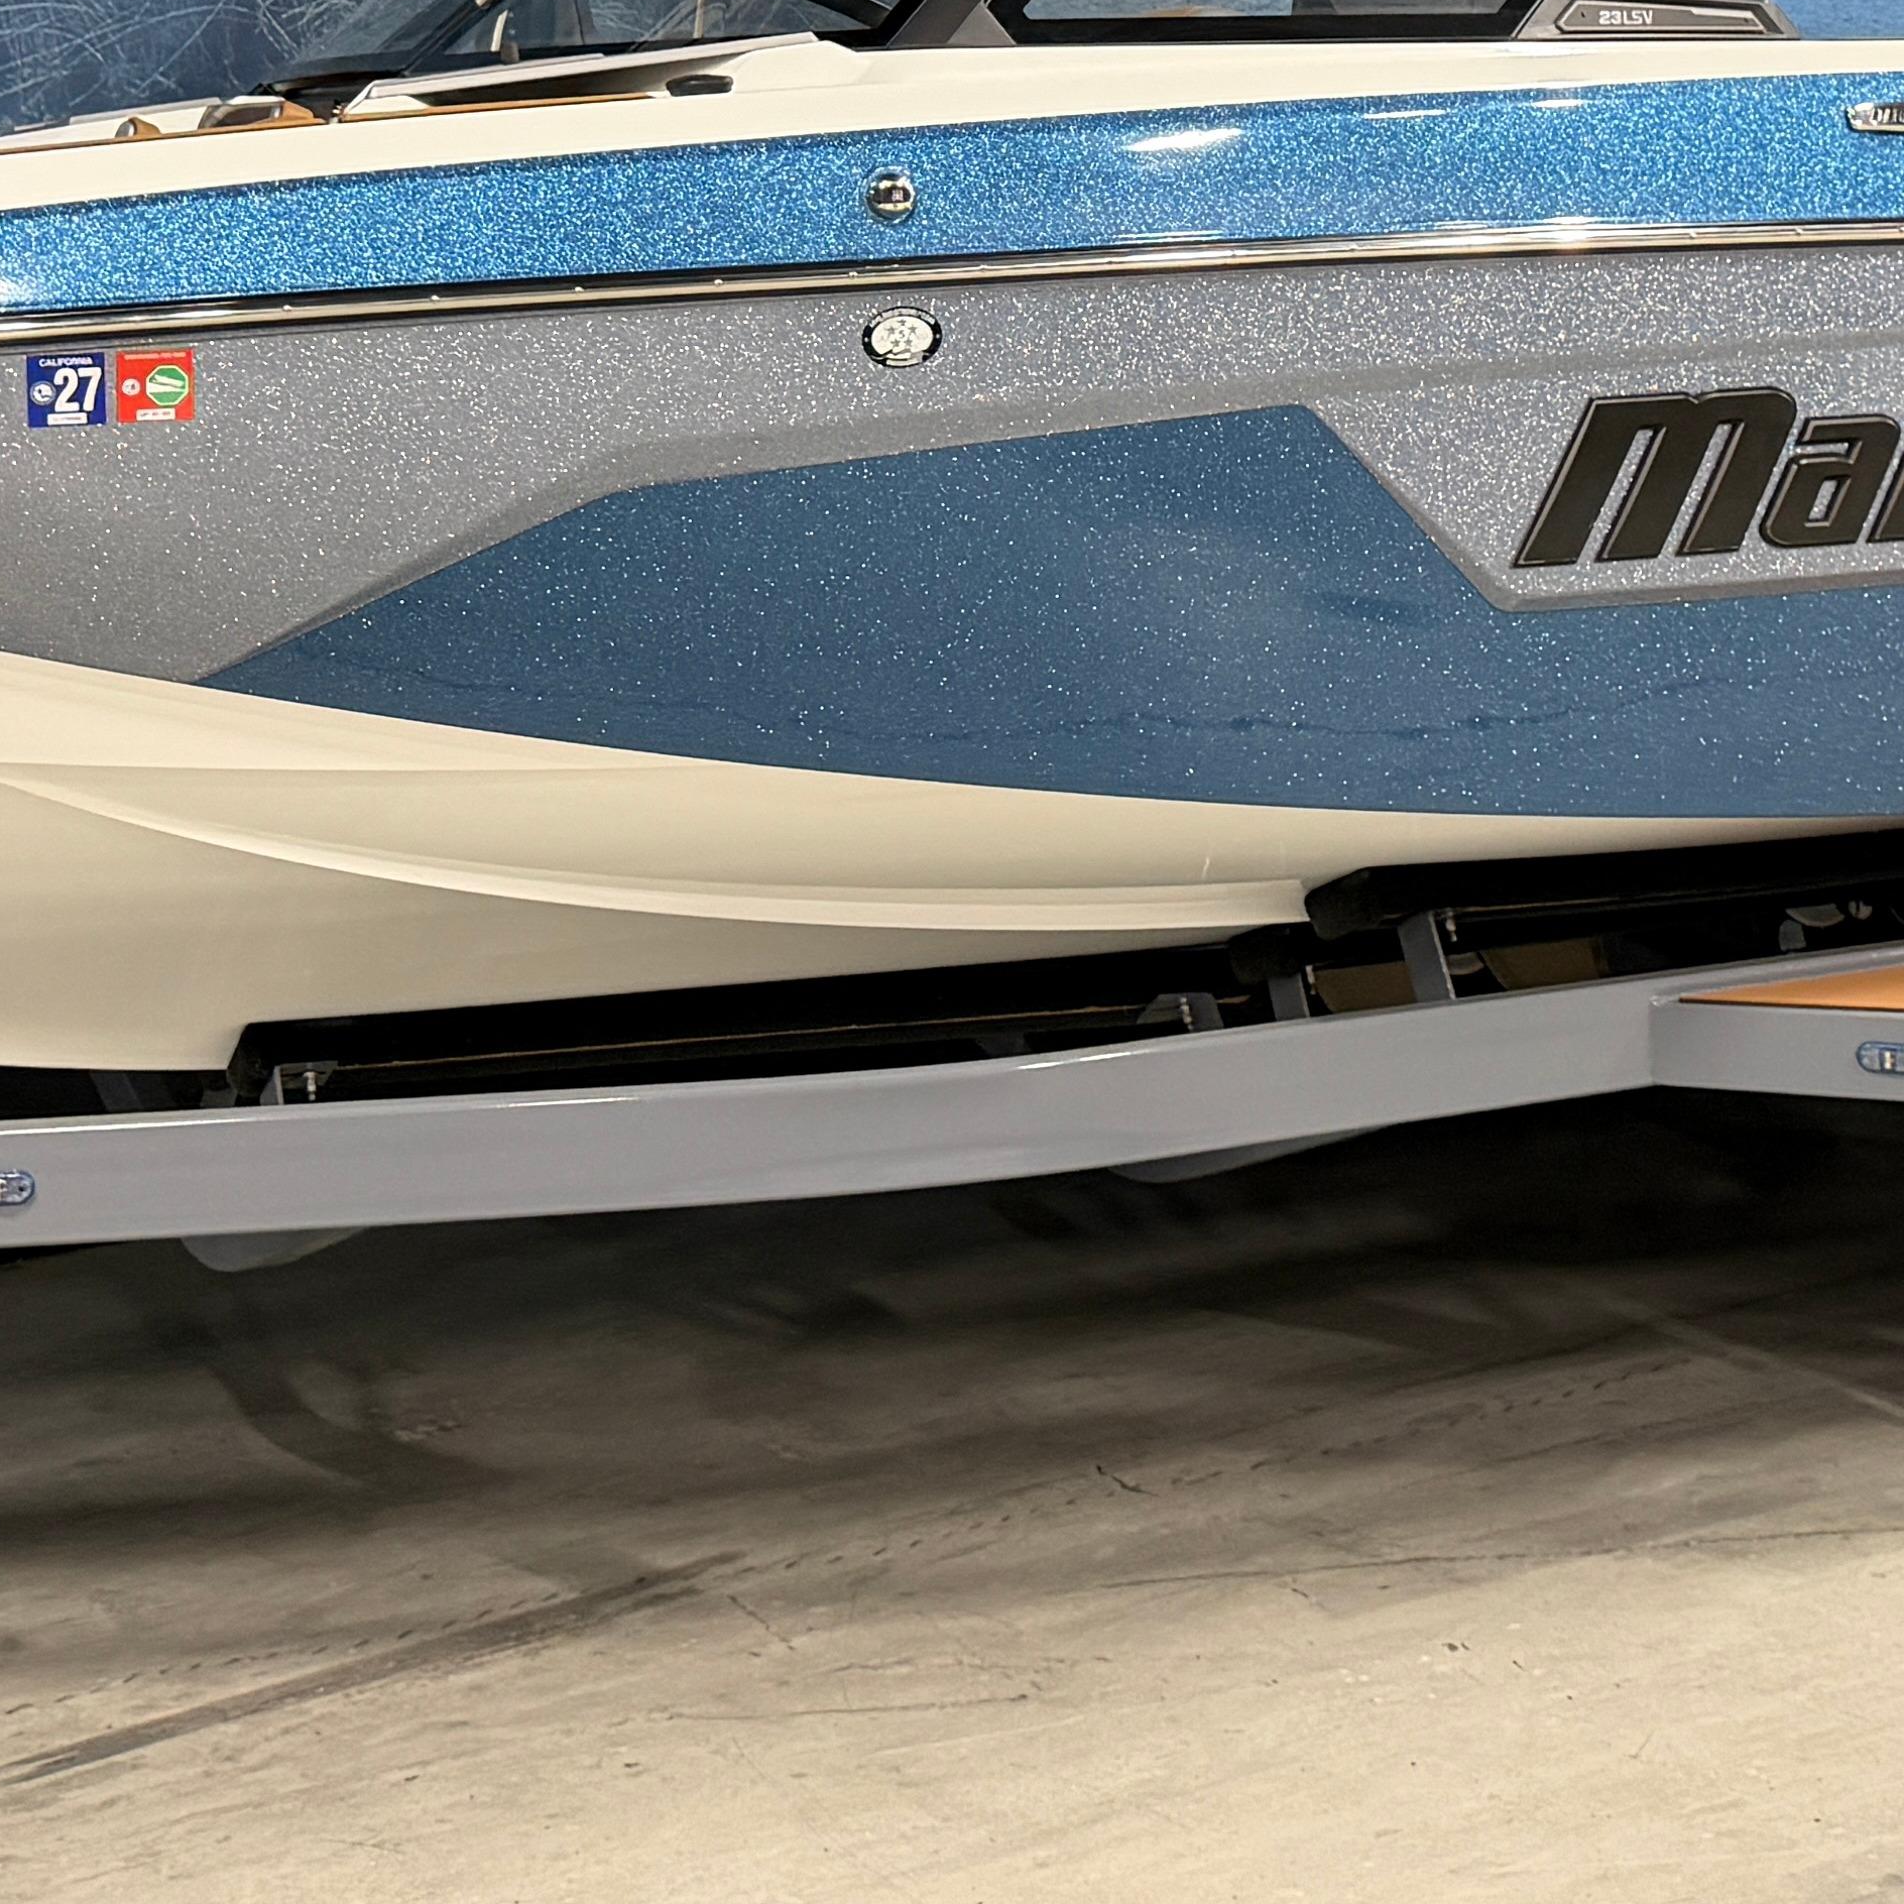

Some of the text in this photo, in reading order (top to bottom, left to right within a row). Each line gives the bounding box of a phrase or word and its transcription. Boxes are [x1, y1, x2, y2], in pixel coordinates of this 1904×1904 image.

[1598, 9, 1654, 26] 23LSV
[38, 356, 94, 367] CALIFORNIA
[53, 367, 102, 413] 27
